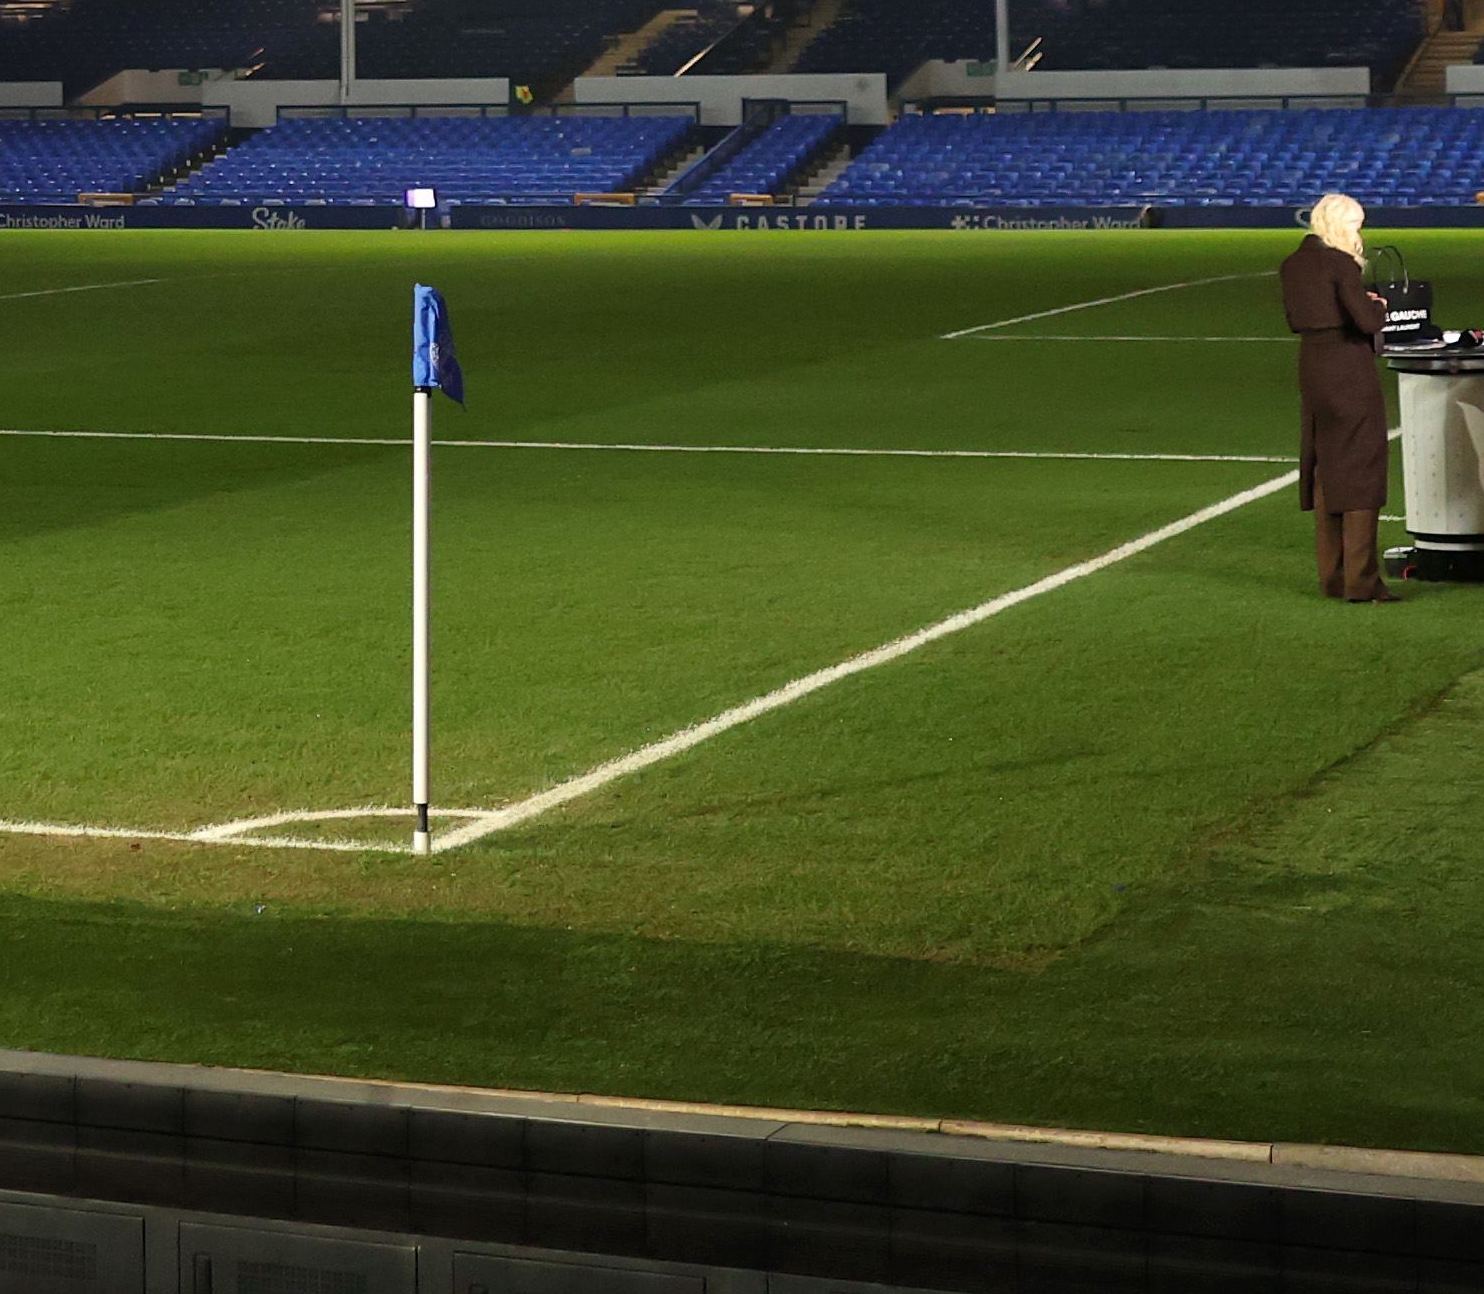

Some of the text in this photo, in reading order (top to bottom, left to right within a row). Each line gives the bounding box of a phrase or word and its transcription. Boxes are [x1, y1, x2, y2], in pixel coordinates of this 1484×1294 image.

[85, 213, 125, 228] Ward
[251, 206, 307, 229] Stake
[480, 213, 566, 227] GOODISON
[736, 213, 867, 230] CASTORE
[982, 214, 1090, 230] Christopher
[1390, 309, 1428, 322] GAUCHE
